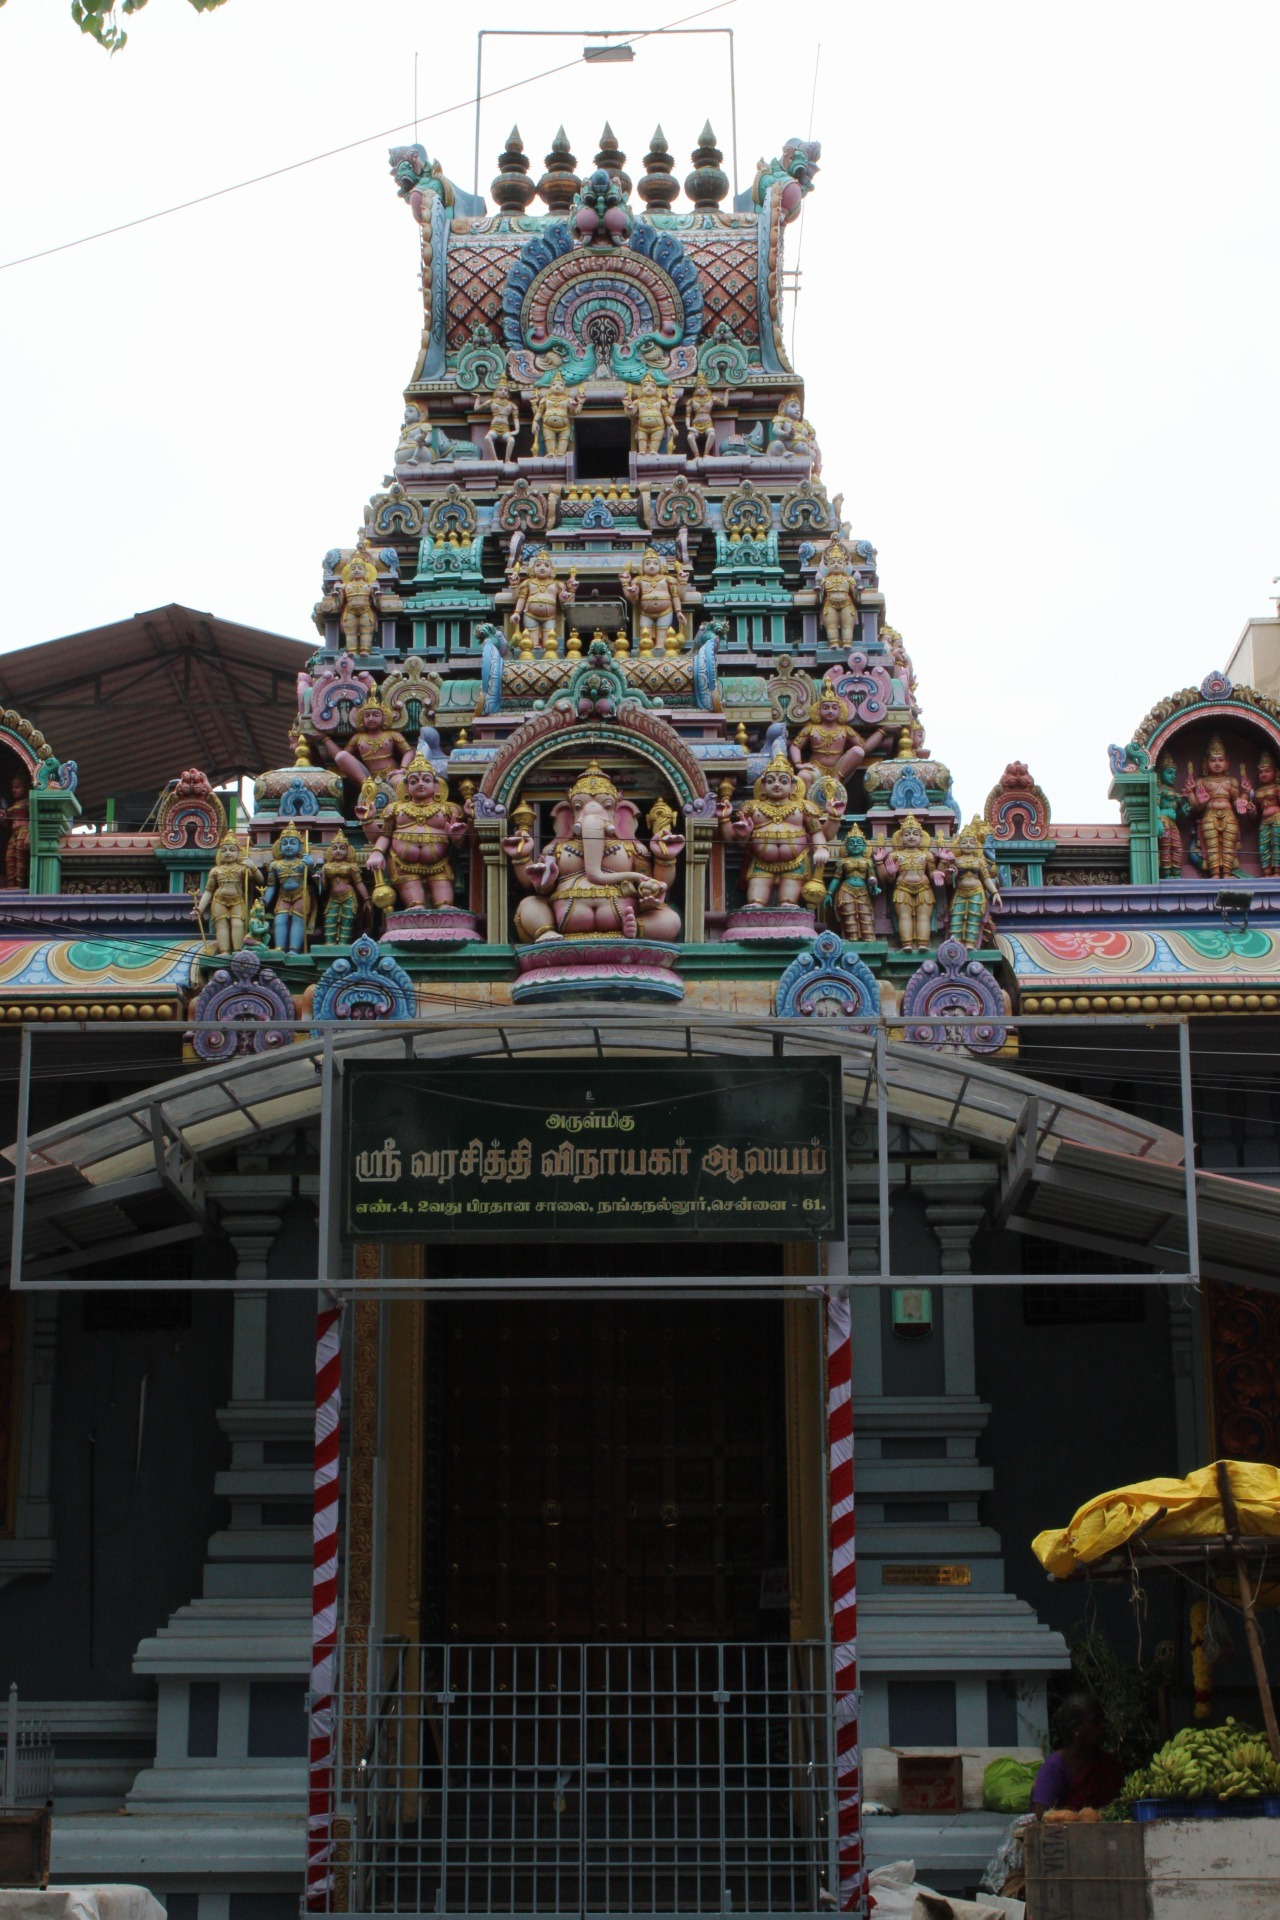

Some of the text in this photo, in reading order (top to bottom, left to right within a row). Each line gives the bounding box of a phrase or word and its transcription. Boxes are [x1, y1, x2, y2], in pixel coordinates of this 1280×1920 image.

[545, 1110, 636, 1133] அருள்மிகு
[410, 1137, 533, 1185] வரசித்தி
[540, 1136, 692, 1184] விநாயகர்
[701, 1136, 827, 1184] ஆலயம்
[417, 1200, 462, 1216] 2வது
[466, 1198, 531, 1215] பிரதான
[535, 1201, 594, 1214] சாலை,
[802, 1198, 827, 1211] 61.
[1043, 1829, 1065, 1873] VISTA
